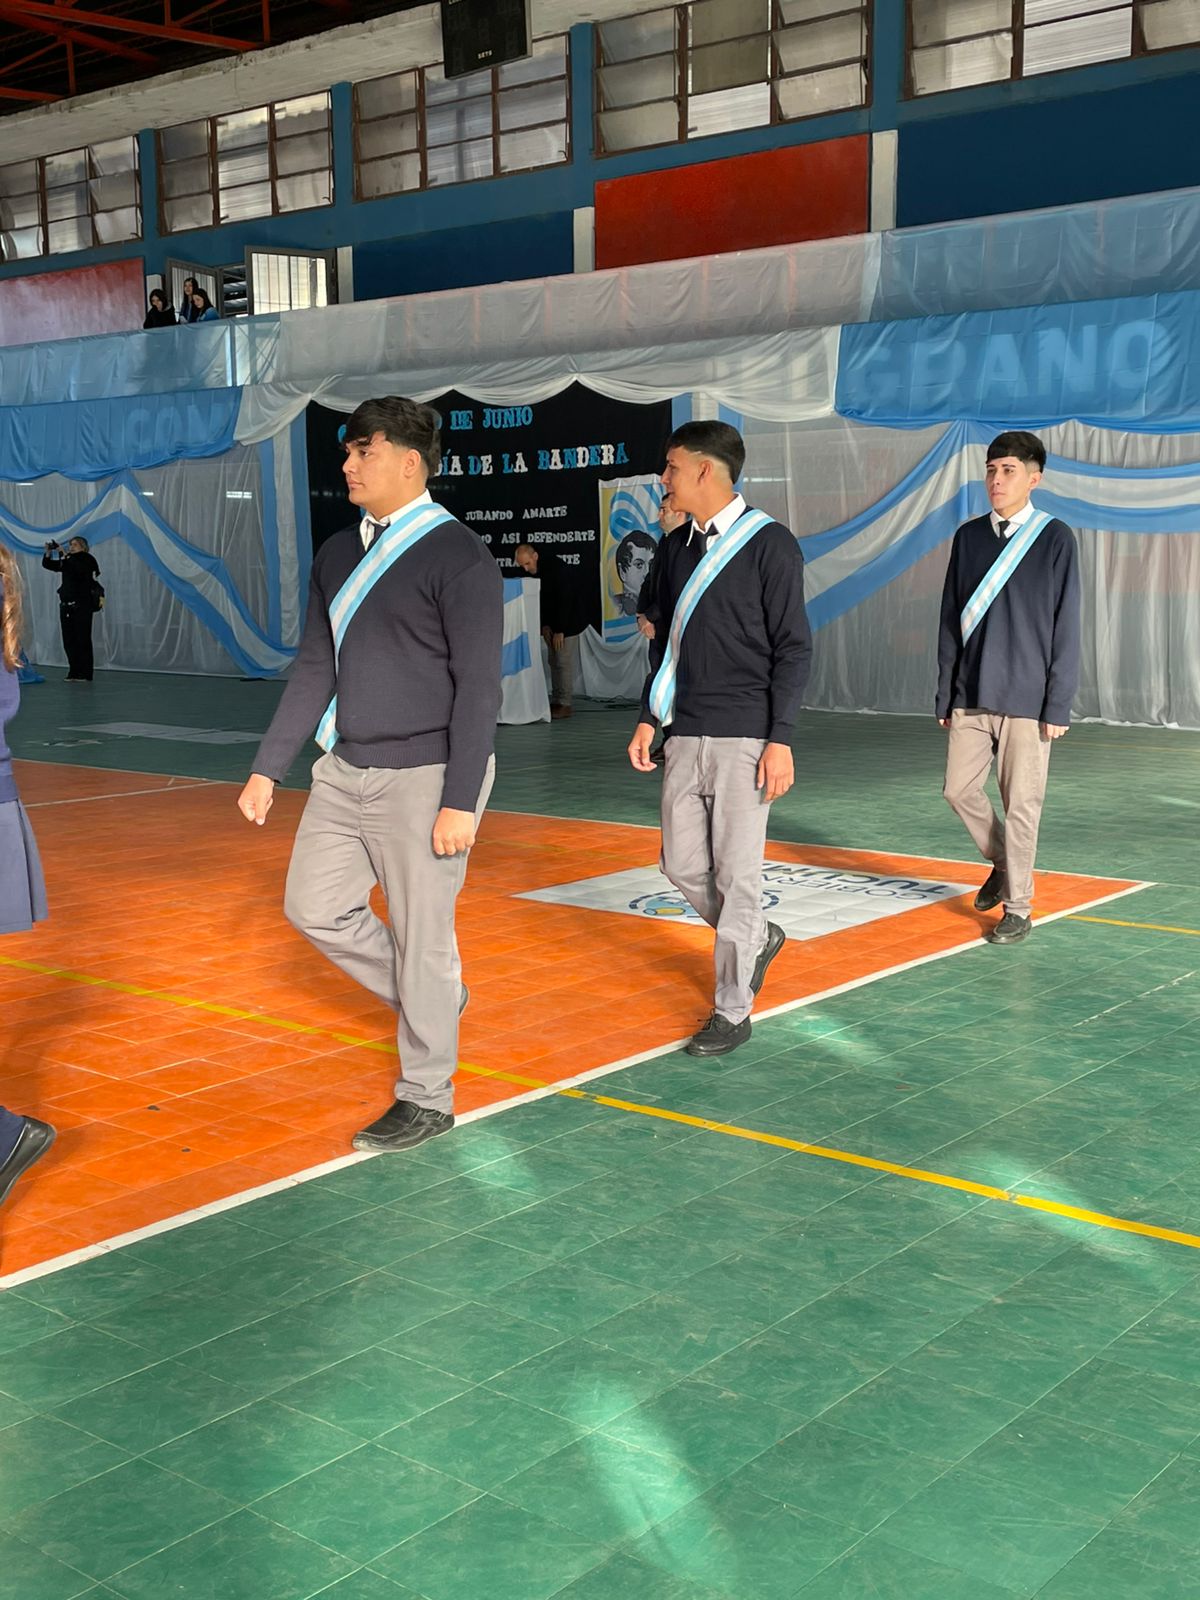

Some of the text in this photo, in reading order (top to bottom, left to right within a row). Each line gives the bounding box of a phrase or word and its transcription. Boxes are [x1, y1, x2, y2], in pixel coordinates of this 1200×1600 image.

[450, 410, 473, 430] DE
[482, 406, 533, 429] JUNIO
[467, 454, 493, 476] DE
[502, 452, 528, 474] LA
[537, 442, 630, 470] BANDERA
[465, 505, 568, 521] JURANDO AMARTE
[501, 532, 521, 544] ASI
[527, 529, 596, 544] DEFENDERTE
[762, 863, 948, 895] TUCUM
[762, 873, 928, 900] GOBIERN
